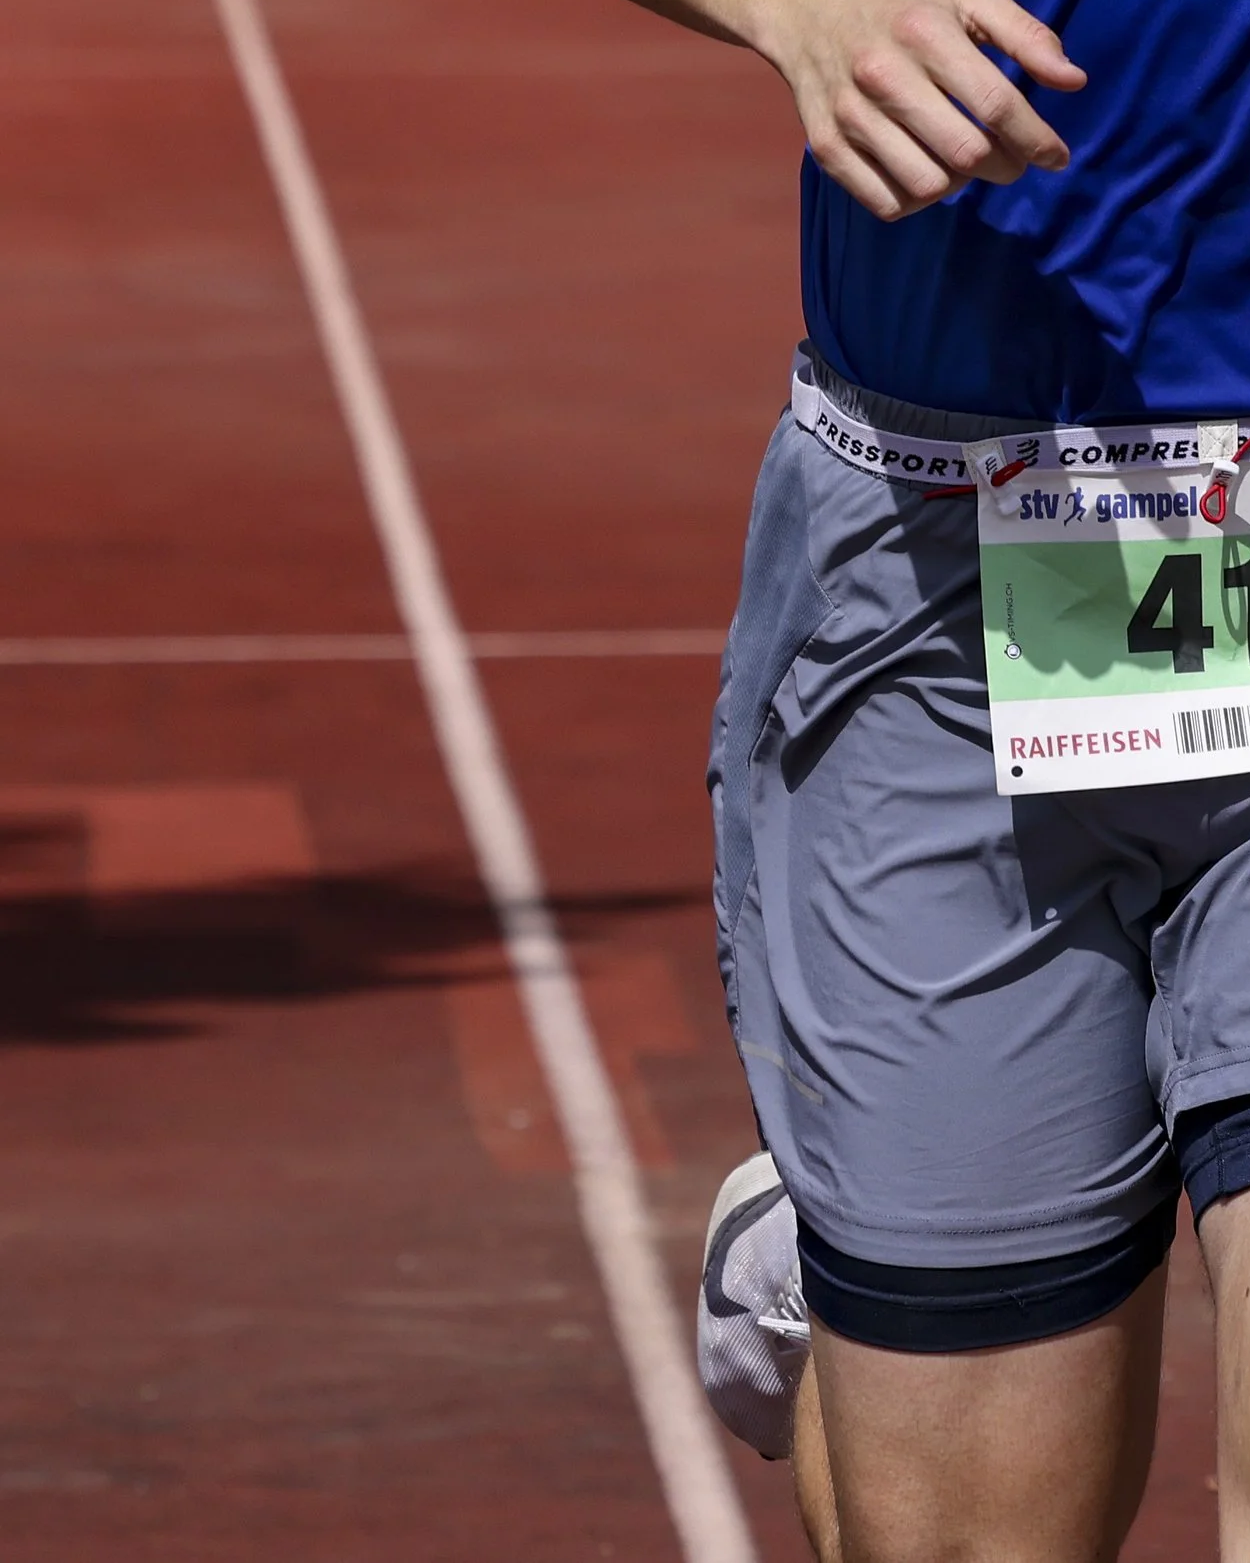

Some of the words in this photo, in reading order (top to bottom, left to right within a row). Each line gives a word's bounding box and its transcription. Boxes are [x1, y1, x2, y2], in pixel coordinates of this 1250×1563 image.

[1020, 489, 1059, 520] stv
[1096, 486, 1198, 522] gampel
[1010, 728, 1162, 759] RAIFFEISEN
